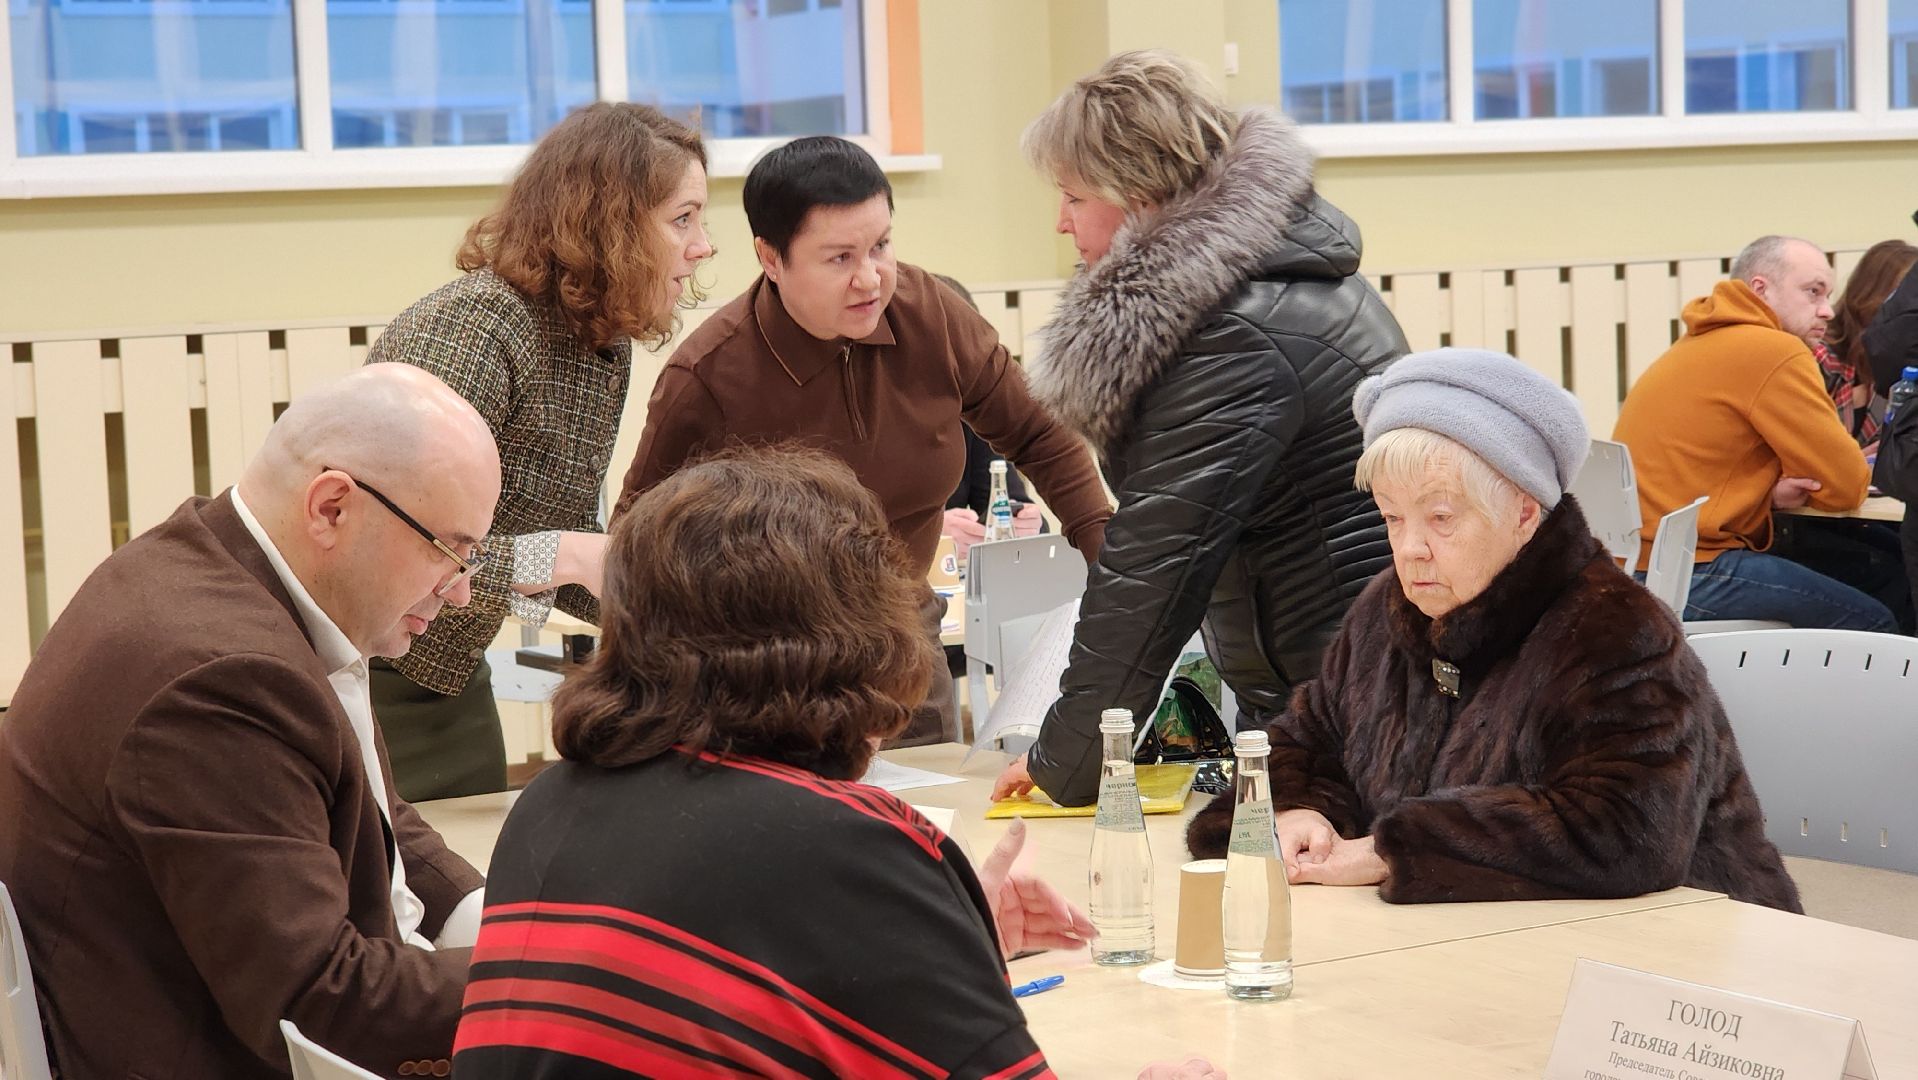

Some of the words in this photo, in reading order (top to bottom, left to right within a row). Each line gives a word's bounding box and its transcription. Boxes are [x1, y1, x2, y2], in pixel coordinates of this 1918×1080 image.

[1667, 1000, 1743, 1041] ГОЛОД
[1608, 1051, 1676, 1080] Председатель
[1610, 1020, 1679, 1057] Татьяна
[1682, 1041, 1785, 1080] Айзиковна
